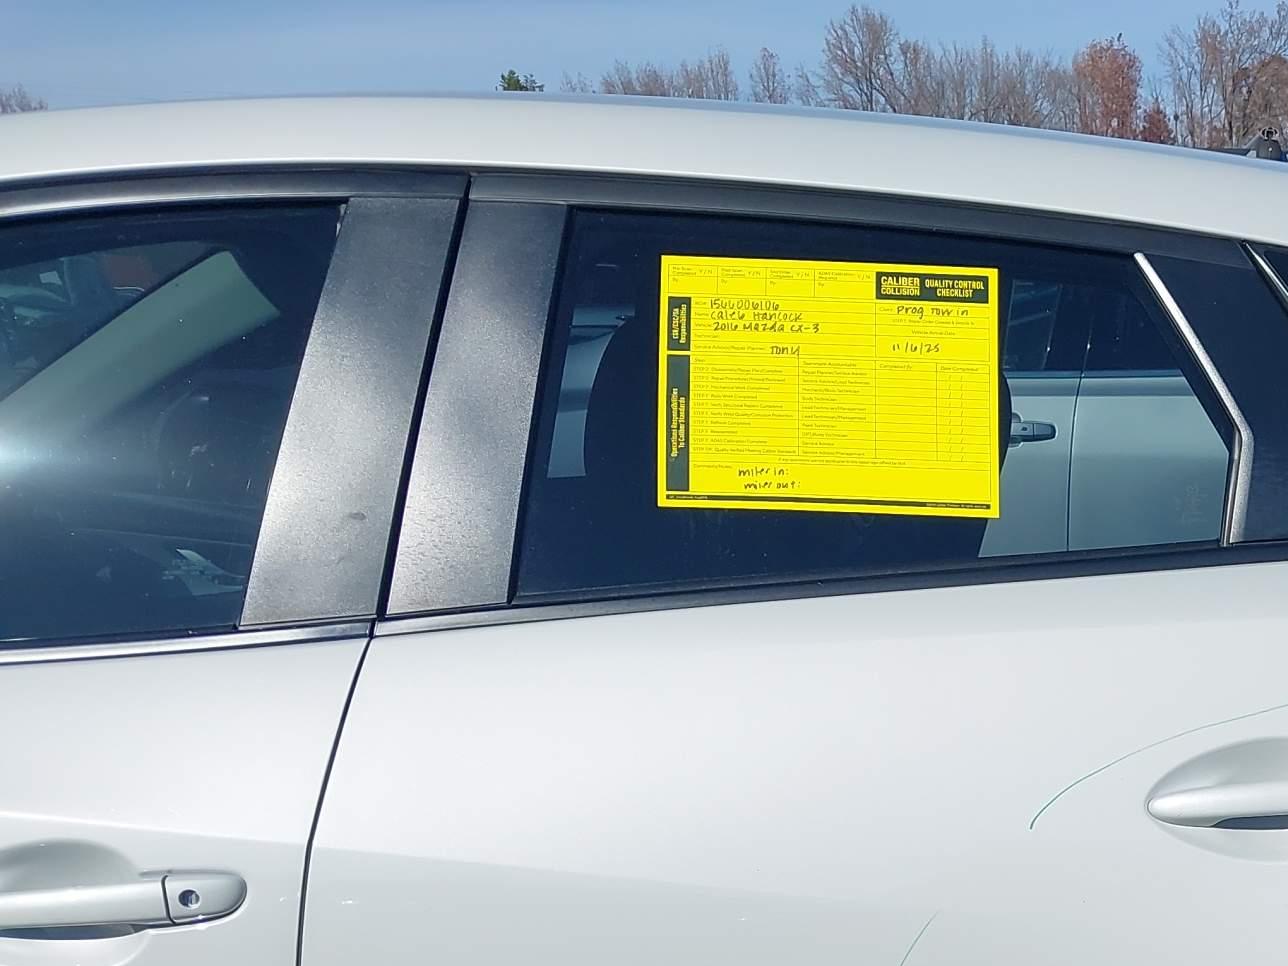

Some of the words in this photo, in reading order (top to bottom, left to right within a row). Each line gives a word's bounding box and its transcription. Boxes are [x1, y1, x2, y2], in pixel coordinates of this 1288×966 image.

[880, 275, 920, 287] CALIBER
[924, 278, 953, 289] QUALITY
[953, 280, 985, 290] CONTROL
[880, 287, 920, 296] COLLISION
[936, 288, 974, 298] CHECKLIST
[713, 321, 739, 332] 2016
